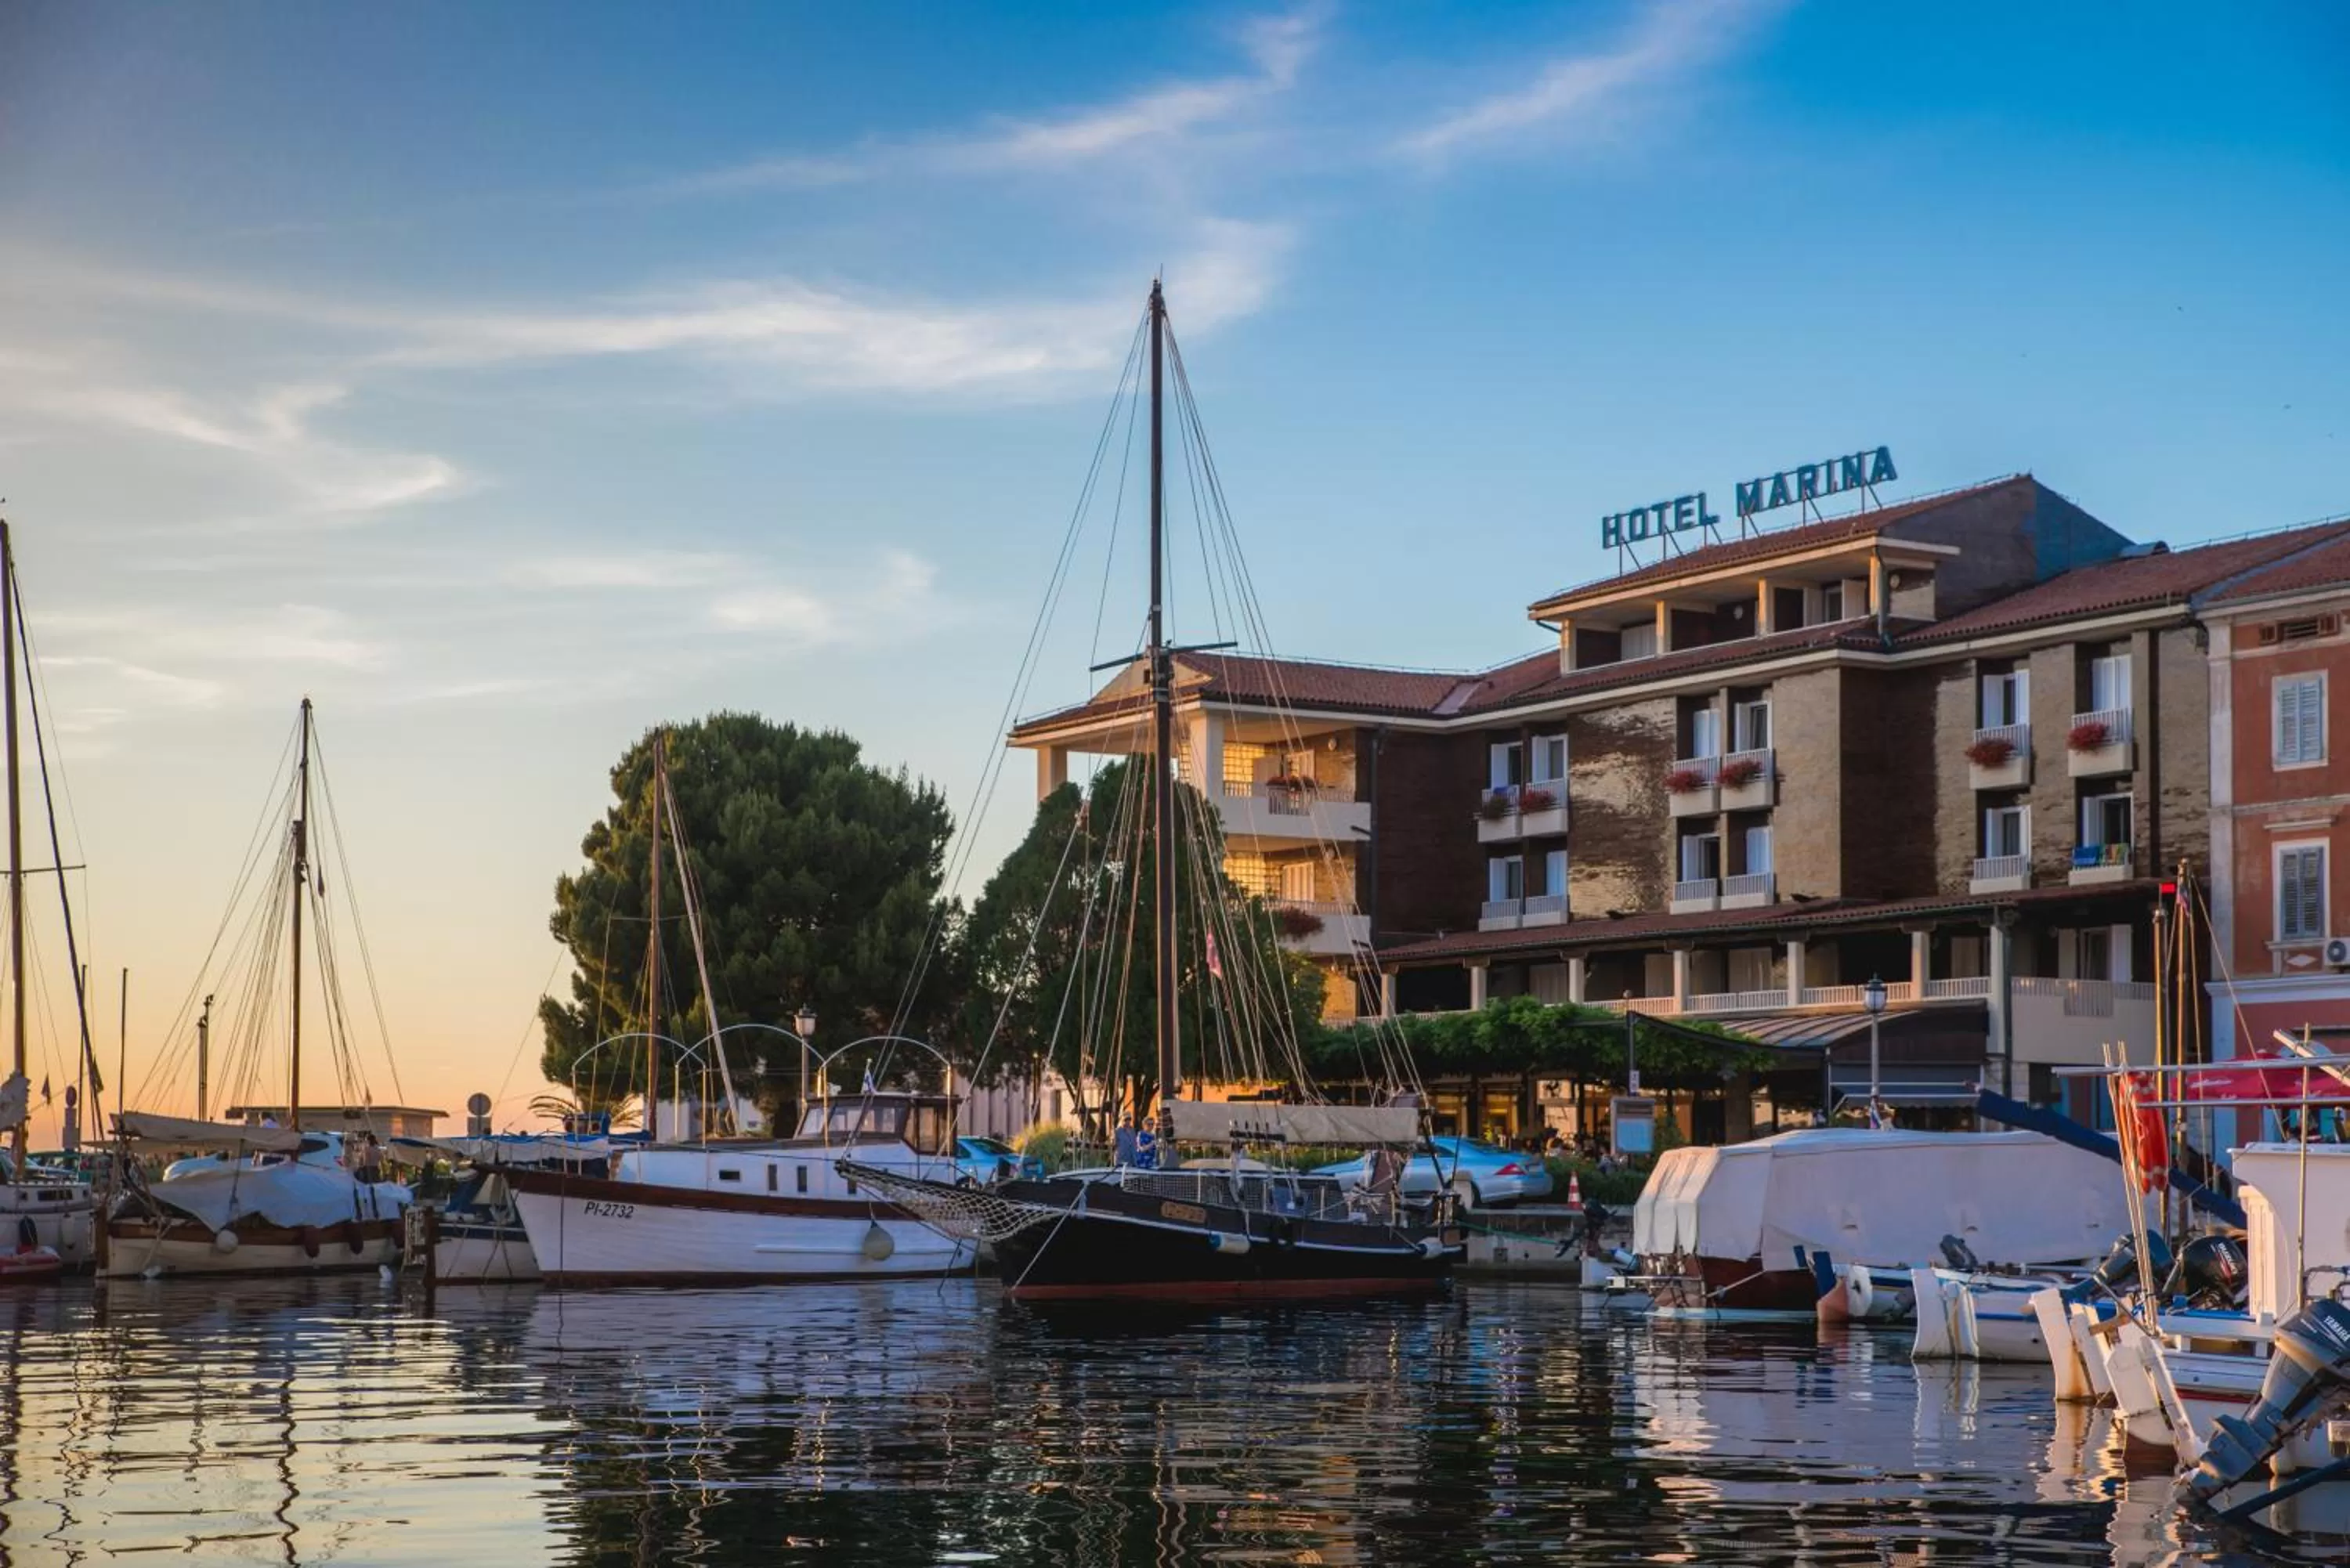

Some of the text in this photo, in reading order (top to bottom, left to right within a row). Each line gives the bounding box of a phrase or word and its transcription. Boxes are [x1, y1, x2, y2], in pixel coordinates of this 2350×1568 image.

[1603, 445, 1897, 549] HOTEL MARINA
[584, 1201, 634, 1219] PI-2732
